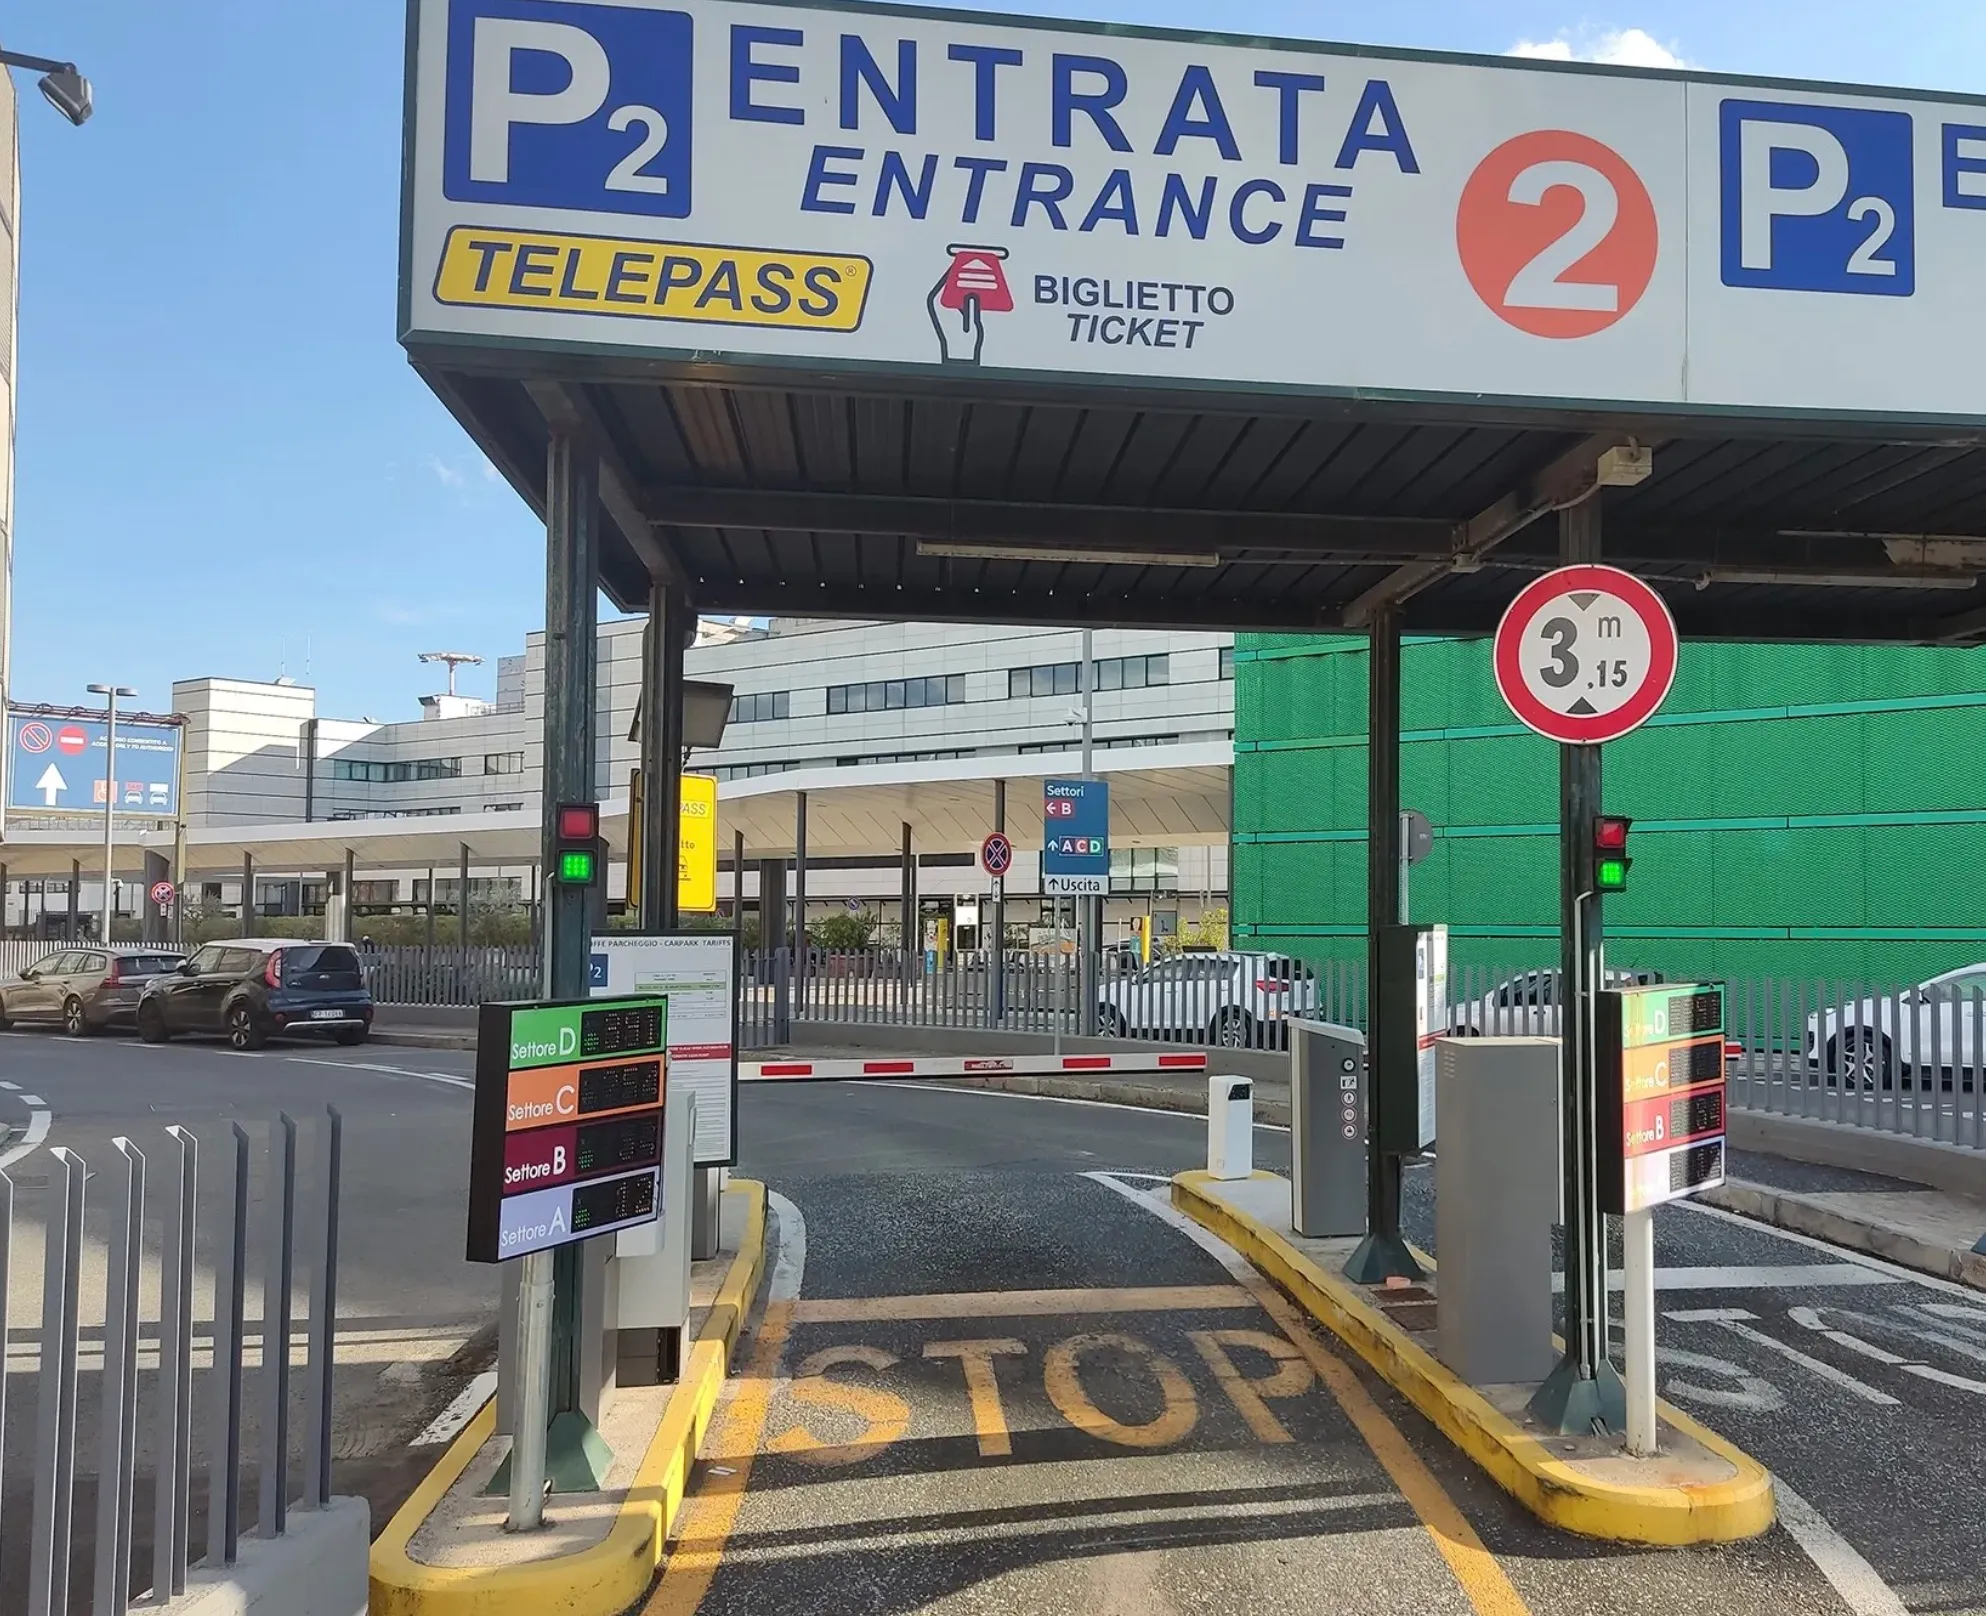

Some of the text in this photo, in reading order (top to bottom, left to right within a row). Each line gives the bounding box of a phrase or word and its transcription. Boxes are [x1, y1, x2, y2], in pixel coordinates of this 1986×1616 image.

[729, 24, 1421, 175] ENTRATA
[800, 144, 1354, 250] ENTRANCE
[1502, 160, 1619, 313] 2
[1034, 274, 1235, 316] BIGLIETTO
[1067, 313, 1205, 349] TICKET
[1597, 616, 1621, 638] m
[1047, 785, 1085, 797] Settori
[1061, 802, 1072, 815] B
[1062, 840, 1101, 853] A C D
[1061, 876, 1100, 892] Uscita
[1654, 1010, 1666, 1035] D
[511, 1027, 577, 1060] Settore D
[1655, 1061, 1668, 1088] C
[508, 1084, 575, 1121] Settore C
[1655, 1114, 1664, 1140] B
[504, 1145, 567, 1184] Settore B
[501, 1206, 566, 1247] Settore A
[765, 1328, 1318, 1466] STOP
